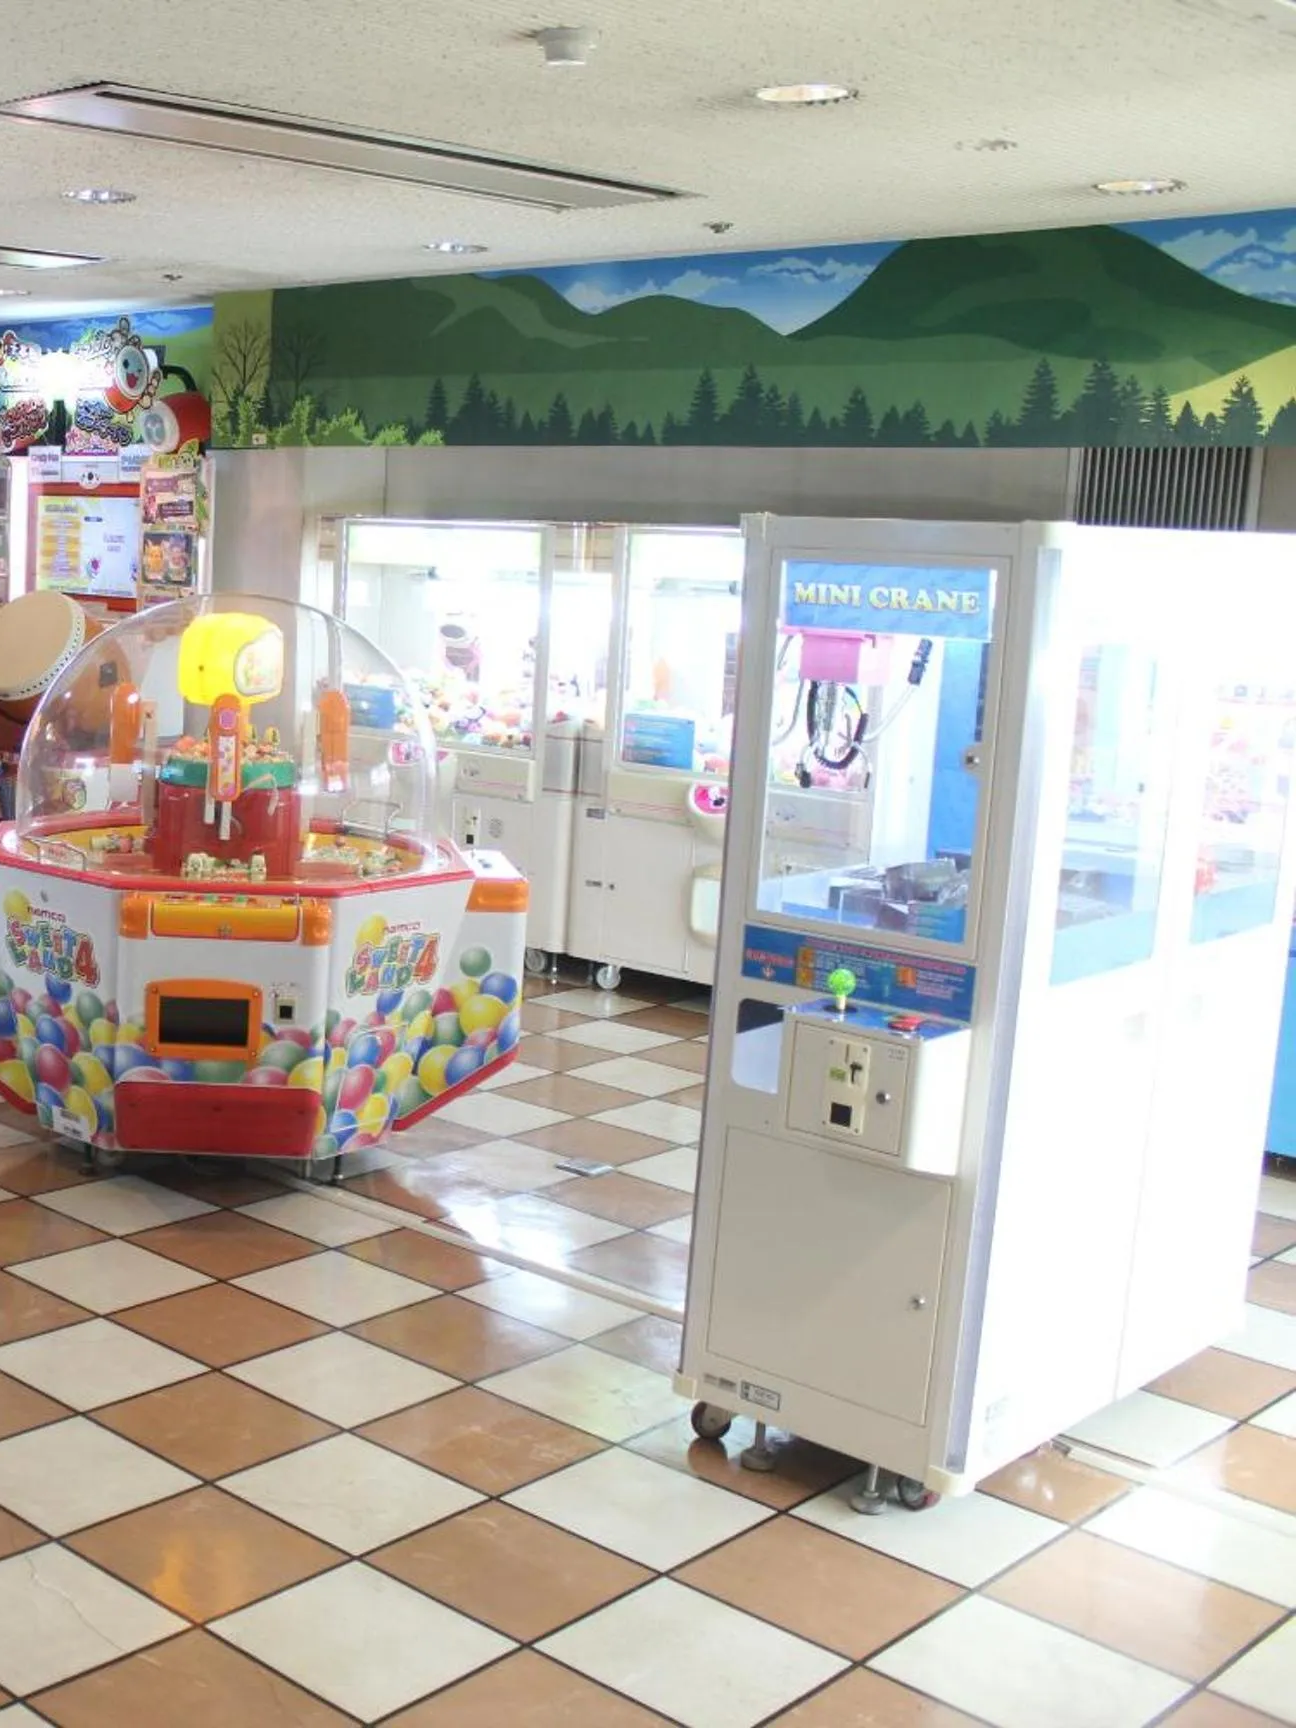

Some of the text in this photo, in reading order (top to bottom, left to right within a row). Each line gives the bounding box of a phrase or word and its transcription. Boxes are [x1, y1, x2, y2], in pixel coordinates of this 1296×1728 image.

[793, 581, 980, 613] MINI CRANE
[27, 905, 66, 922] namco
[382, 921, 421, 934] namco
[73, 933, 100, 988] 4
[412, 933, 440, 984] 4
